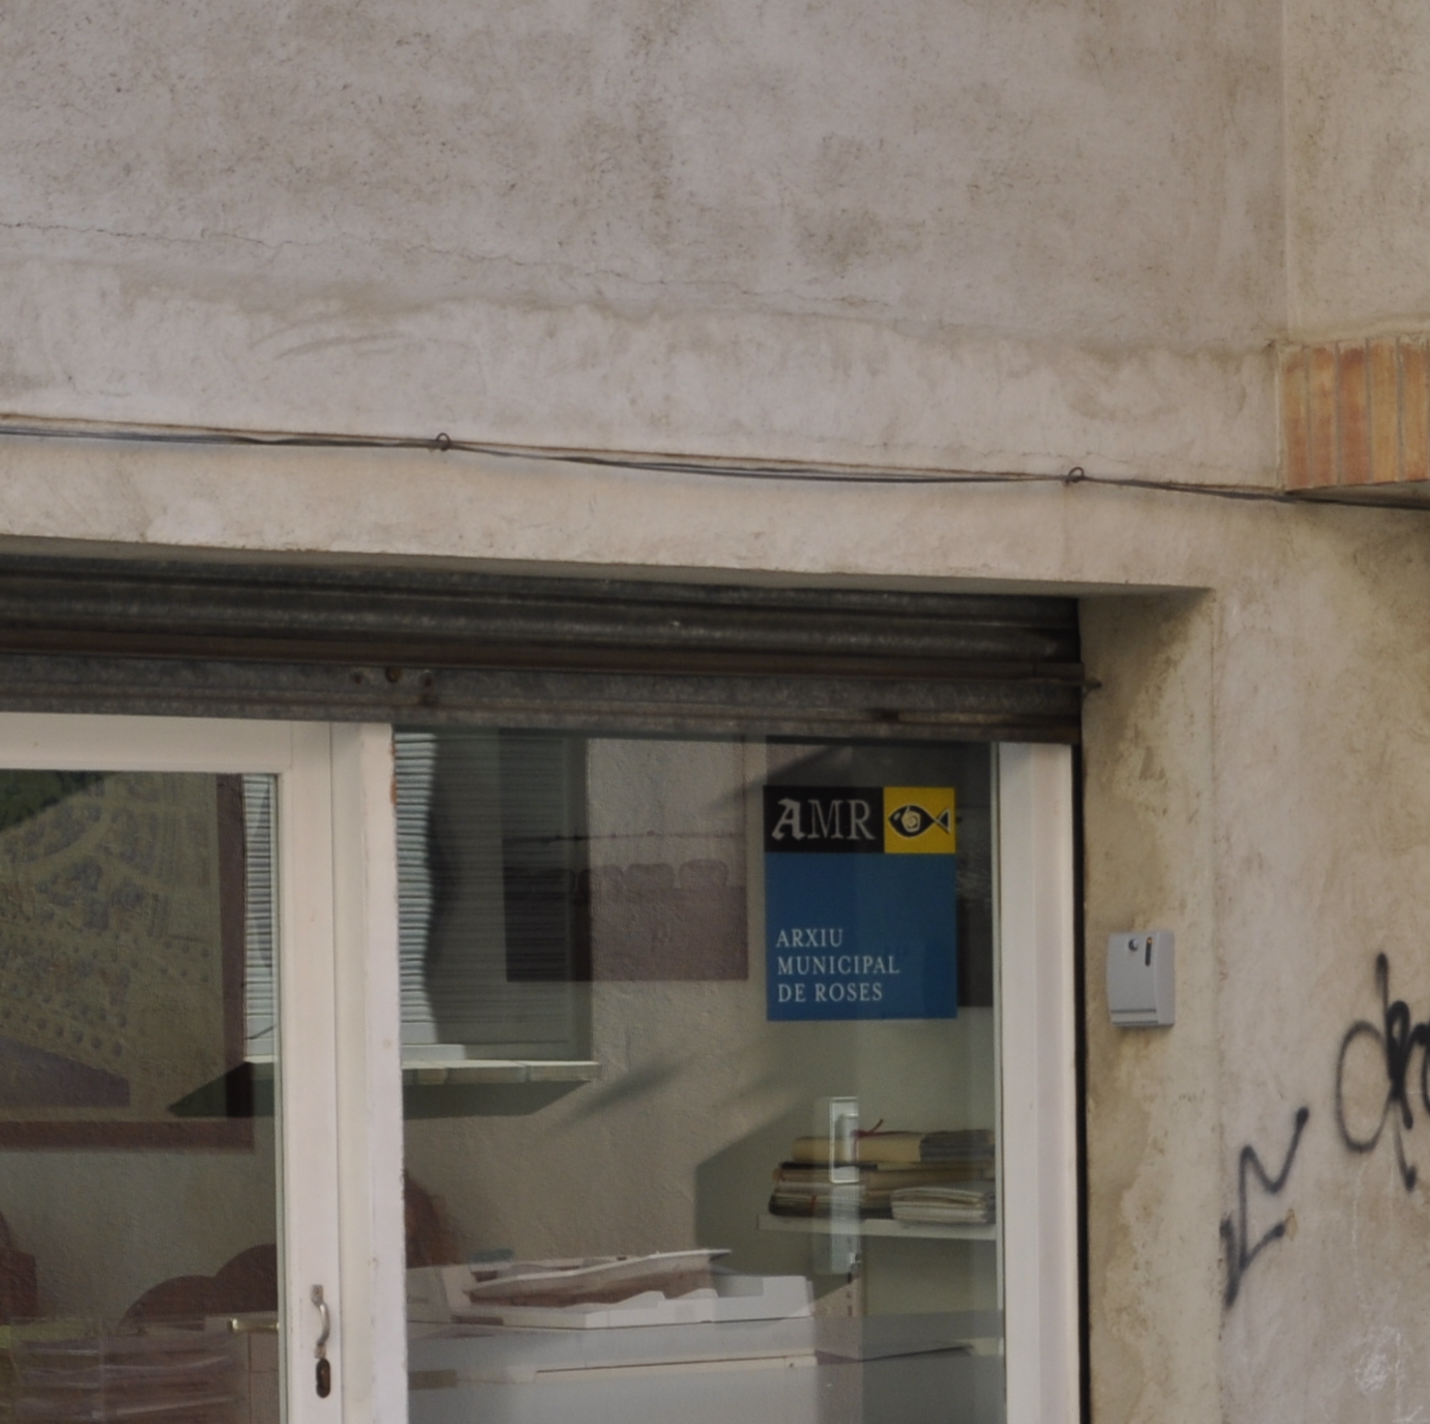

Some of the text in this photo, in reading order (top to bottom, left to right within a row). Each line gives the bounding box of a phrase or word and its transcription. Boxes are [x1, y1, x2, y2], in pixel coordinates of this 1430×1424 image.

[771, 798, 875, 840] AMR
[775, 928, 844, 948] ARXIU
[777, 954, 900, 976] MUNICIPAL
[777, 982, 883, 1003] DE ROSES
